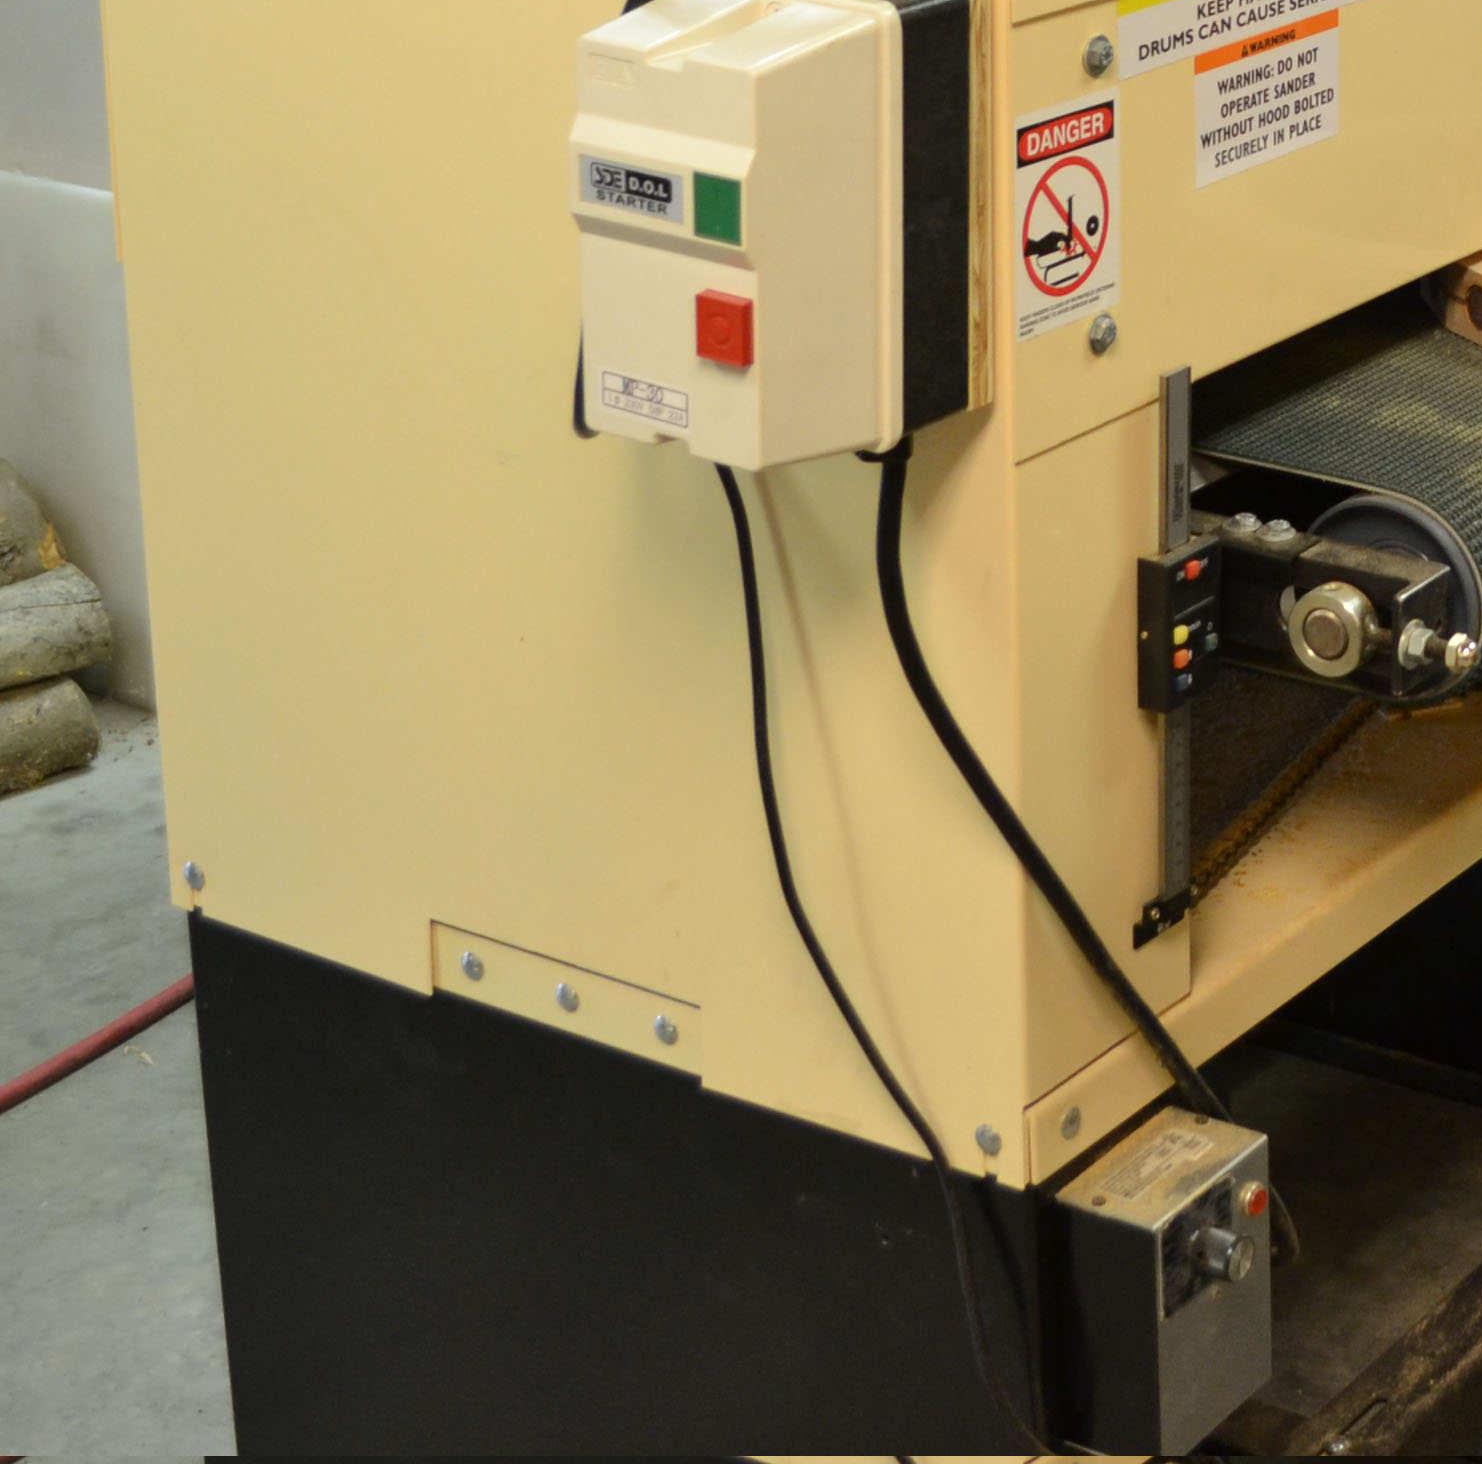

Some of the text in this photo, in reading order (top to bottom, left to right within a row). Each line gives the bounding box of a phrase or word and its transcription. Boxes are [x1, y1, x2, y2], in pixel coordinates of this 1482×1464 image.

[1138, 29, 1195, 61] DRUMS
[1198, 16, 1232, 40] CAN
[1236, 0, 1286, 28] CAUSE
[1249, 29, 1297, 52] WARNING
[1217, 47, 1319, 96] WARNING: DO NOT
[1220, 72, 1316, 118] OPERATE SANDER
[1026, 110, 1105, 157] DANGER
[1201, 87, 1335, 149] WITHOUT HOOD BOLTED
[1214, 113, 1322, 168] SECURELY IN PLACE
[595, 189, 669, 215] STARTER
